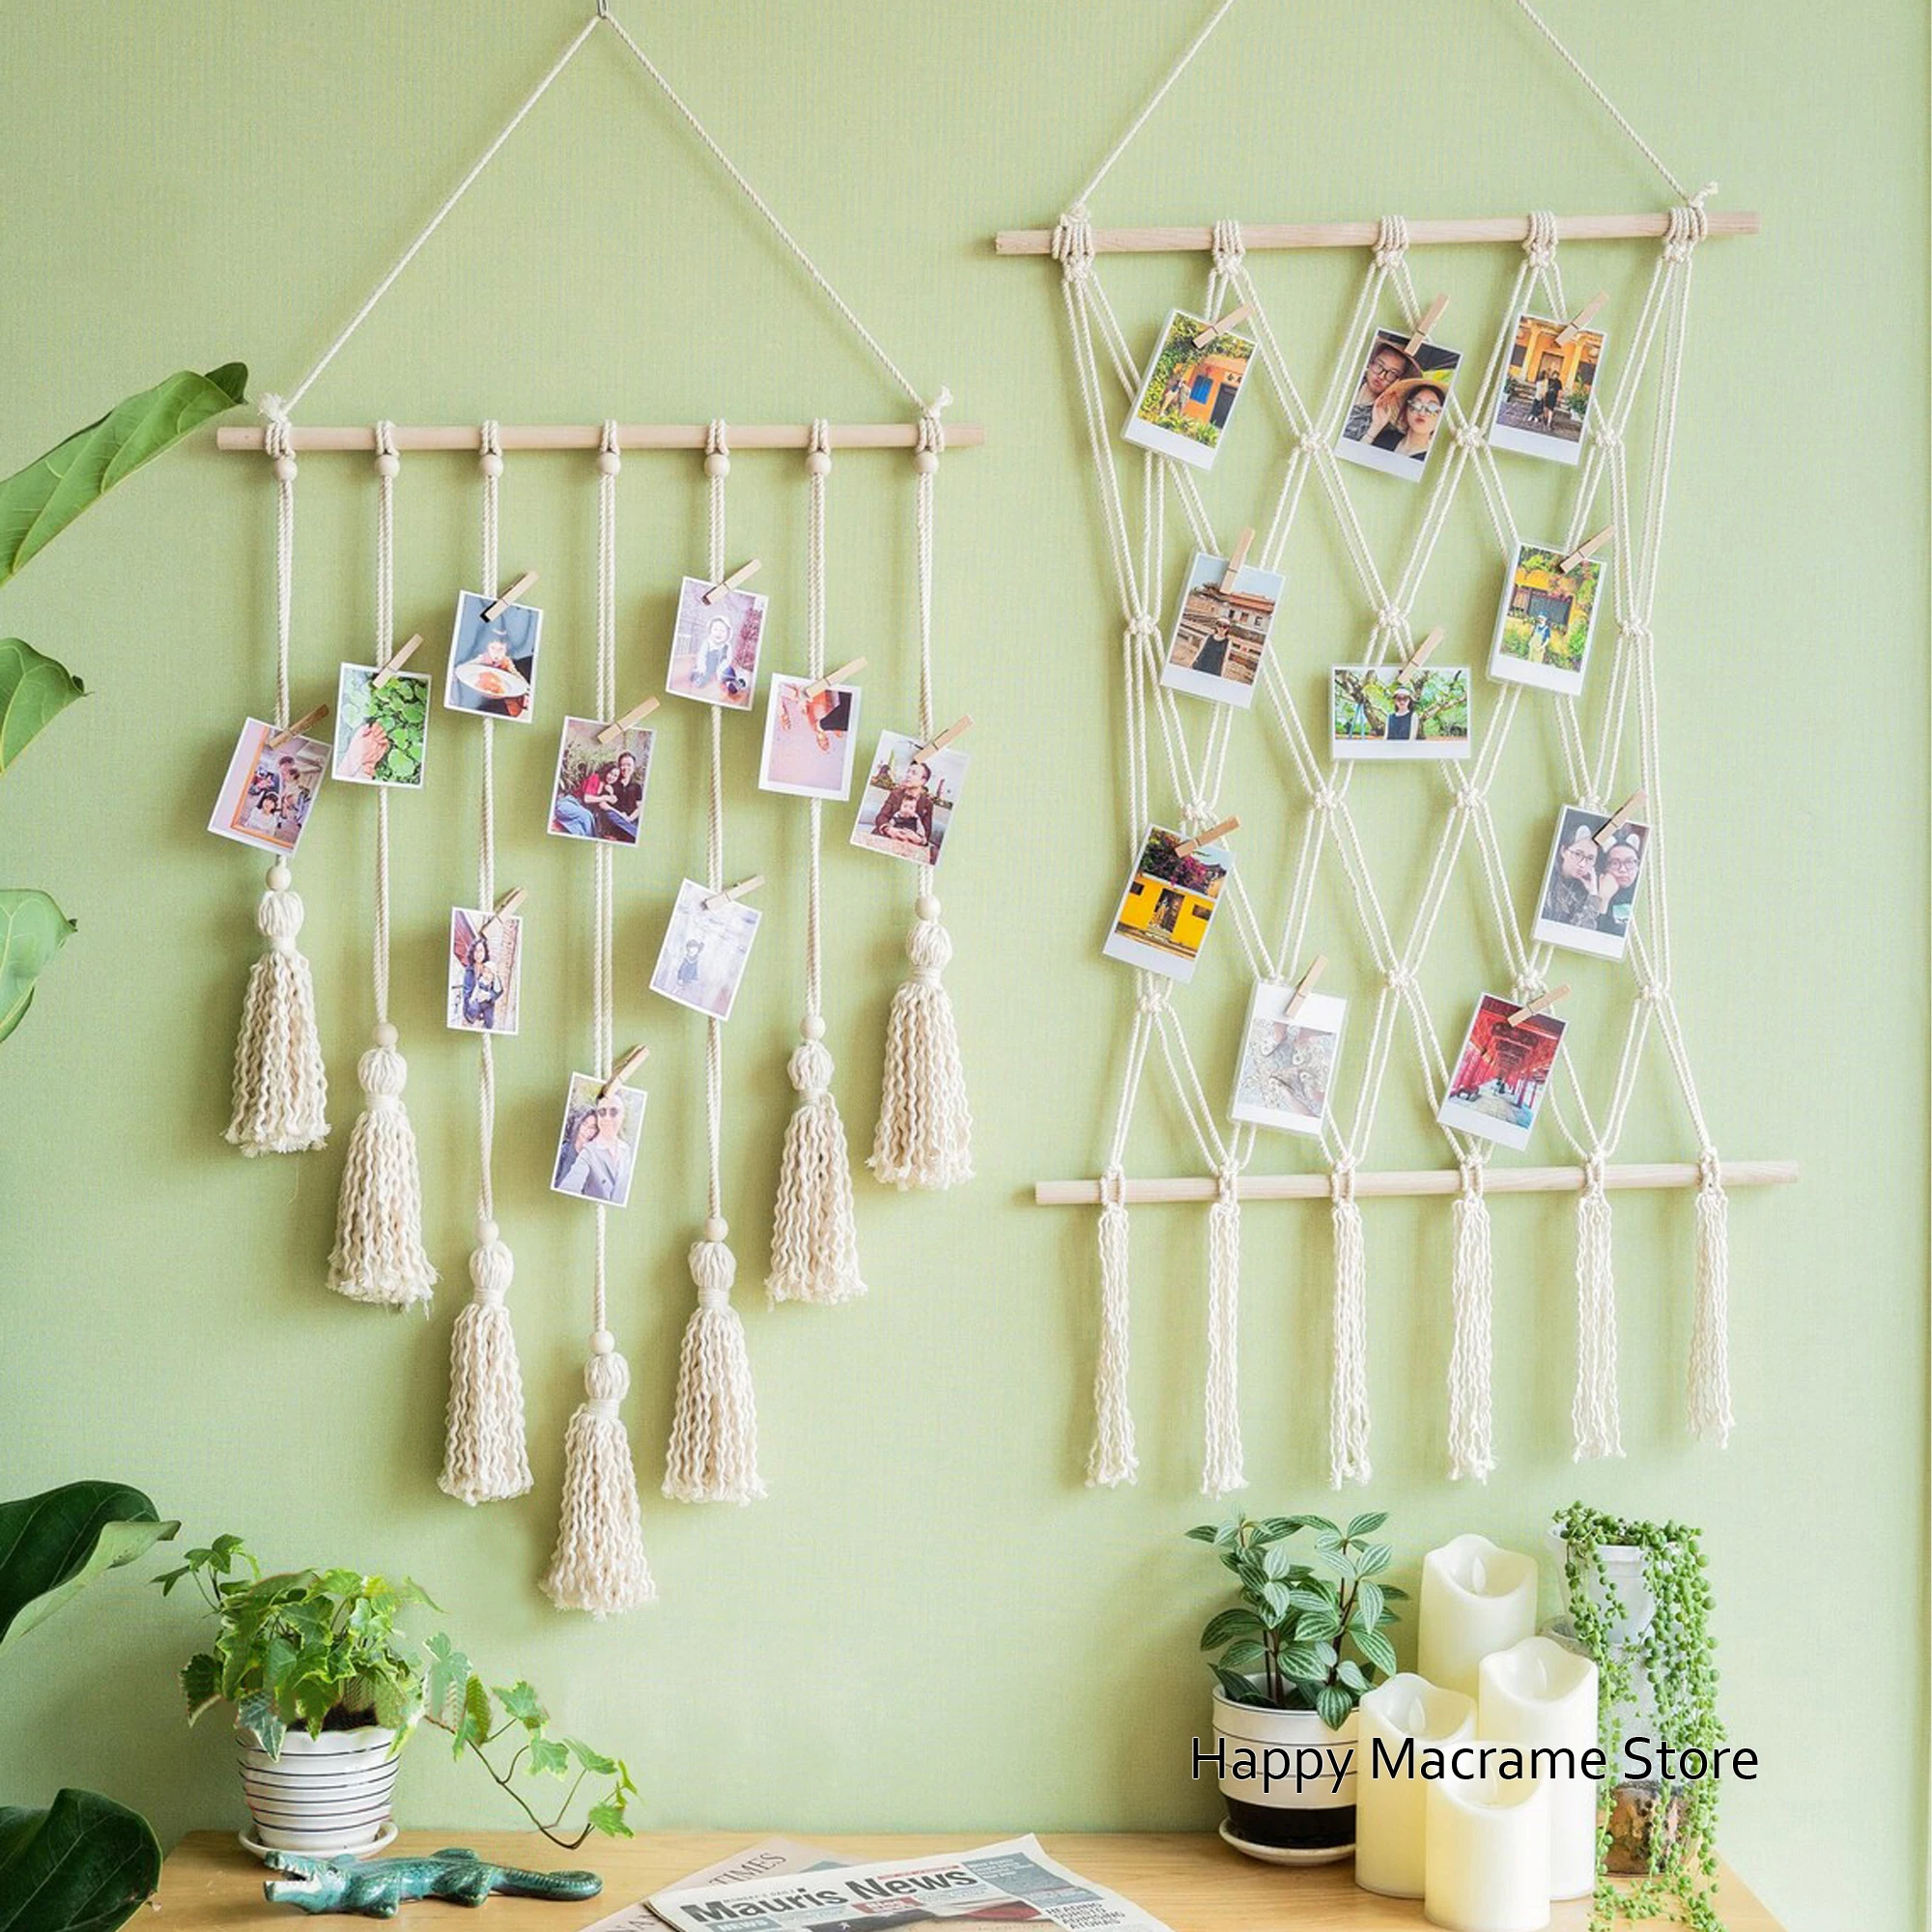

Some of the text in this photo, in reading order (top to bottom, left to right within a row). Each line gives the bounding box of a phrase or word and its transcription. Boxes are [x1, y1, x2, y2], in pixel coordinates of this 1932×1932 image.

[709, 1852, 787, 1885] TIMES
[680, 1888, 848, 1922] Mauris
[845, 1871, 978, 1900] News
